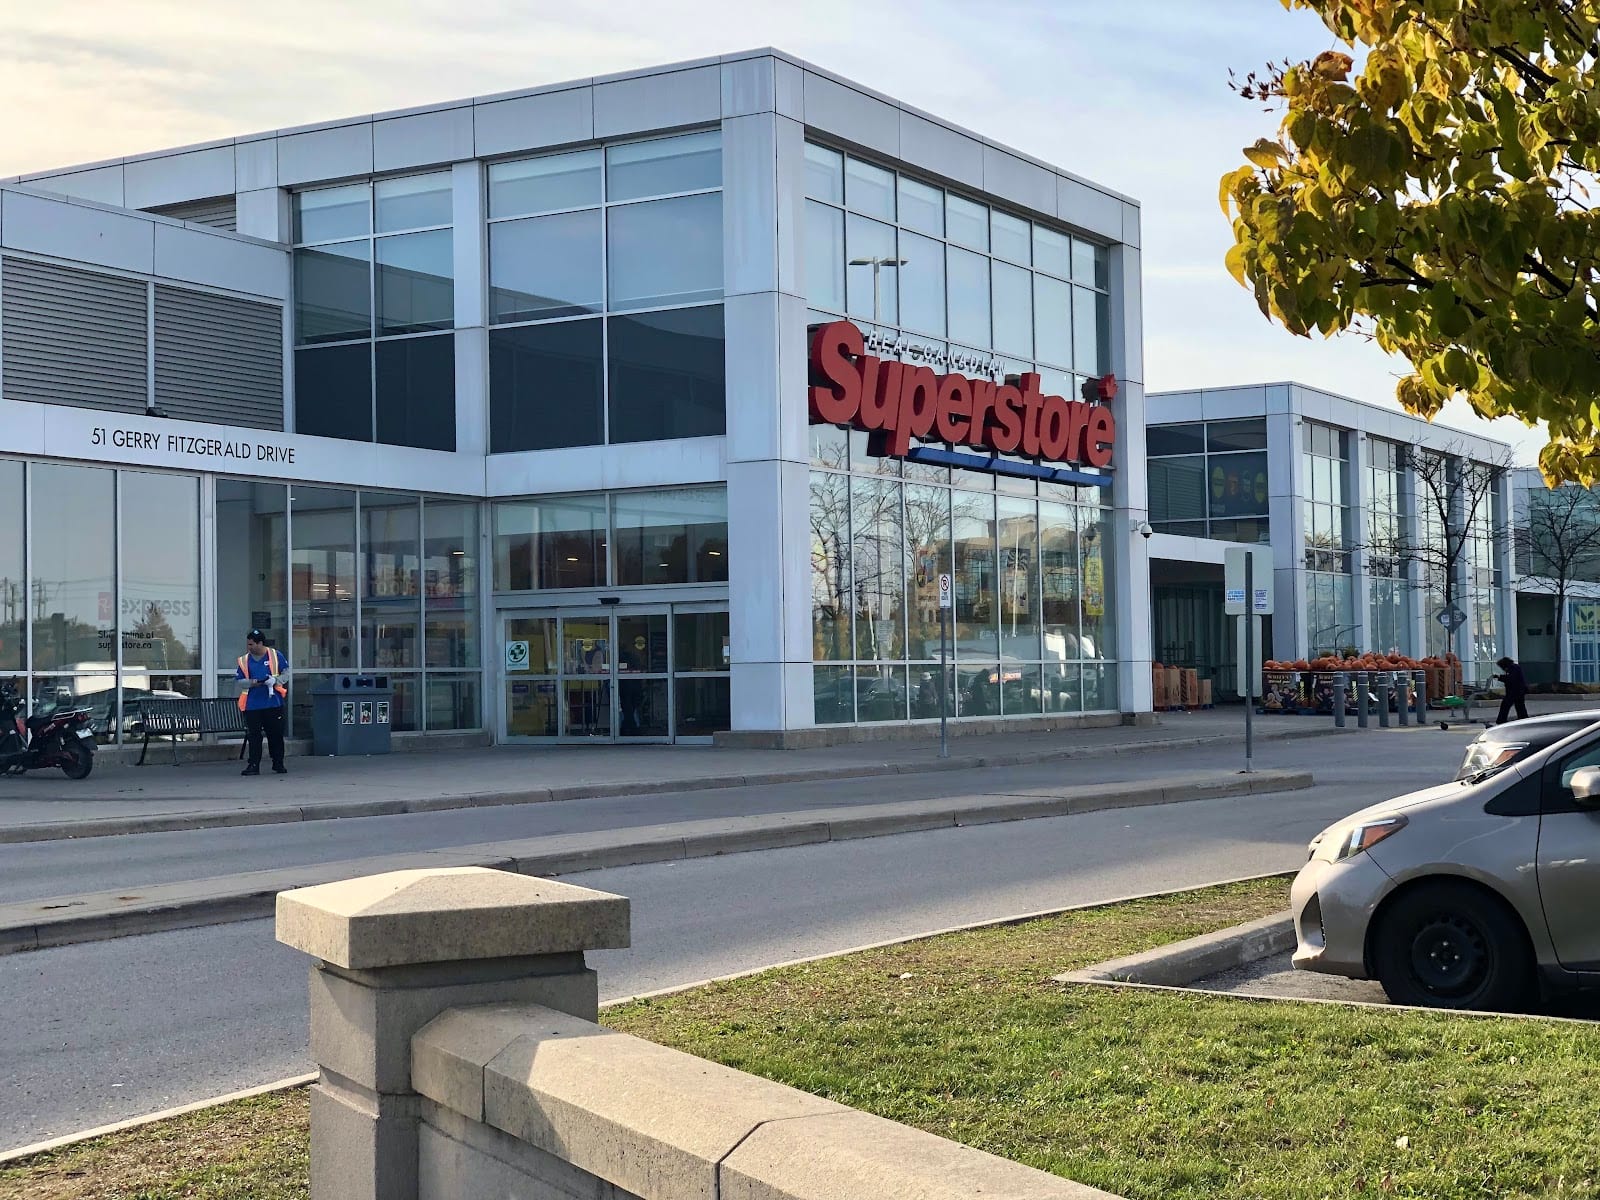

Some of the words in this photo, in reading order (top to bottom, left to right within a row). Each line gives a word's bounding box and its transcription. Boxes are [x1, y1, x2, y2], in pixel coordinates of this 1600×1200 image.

[868, 330, 914, 355] REAL
[923, 344, 1006, 376] CANADIAN
[808, 321, 1115, 468] Superstore
[91, 427, 106, 445] 51
[112, 429, 161, 450] GERRY
[168, 435, 251, 459] FITZGERALD
[257, 444, 295, 464] DRIVE
[121, 599, 190, 620] express
[98, 640, 152, 652] suptore.ca
